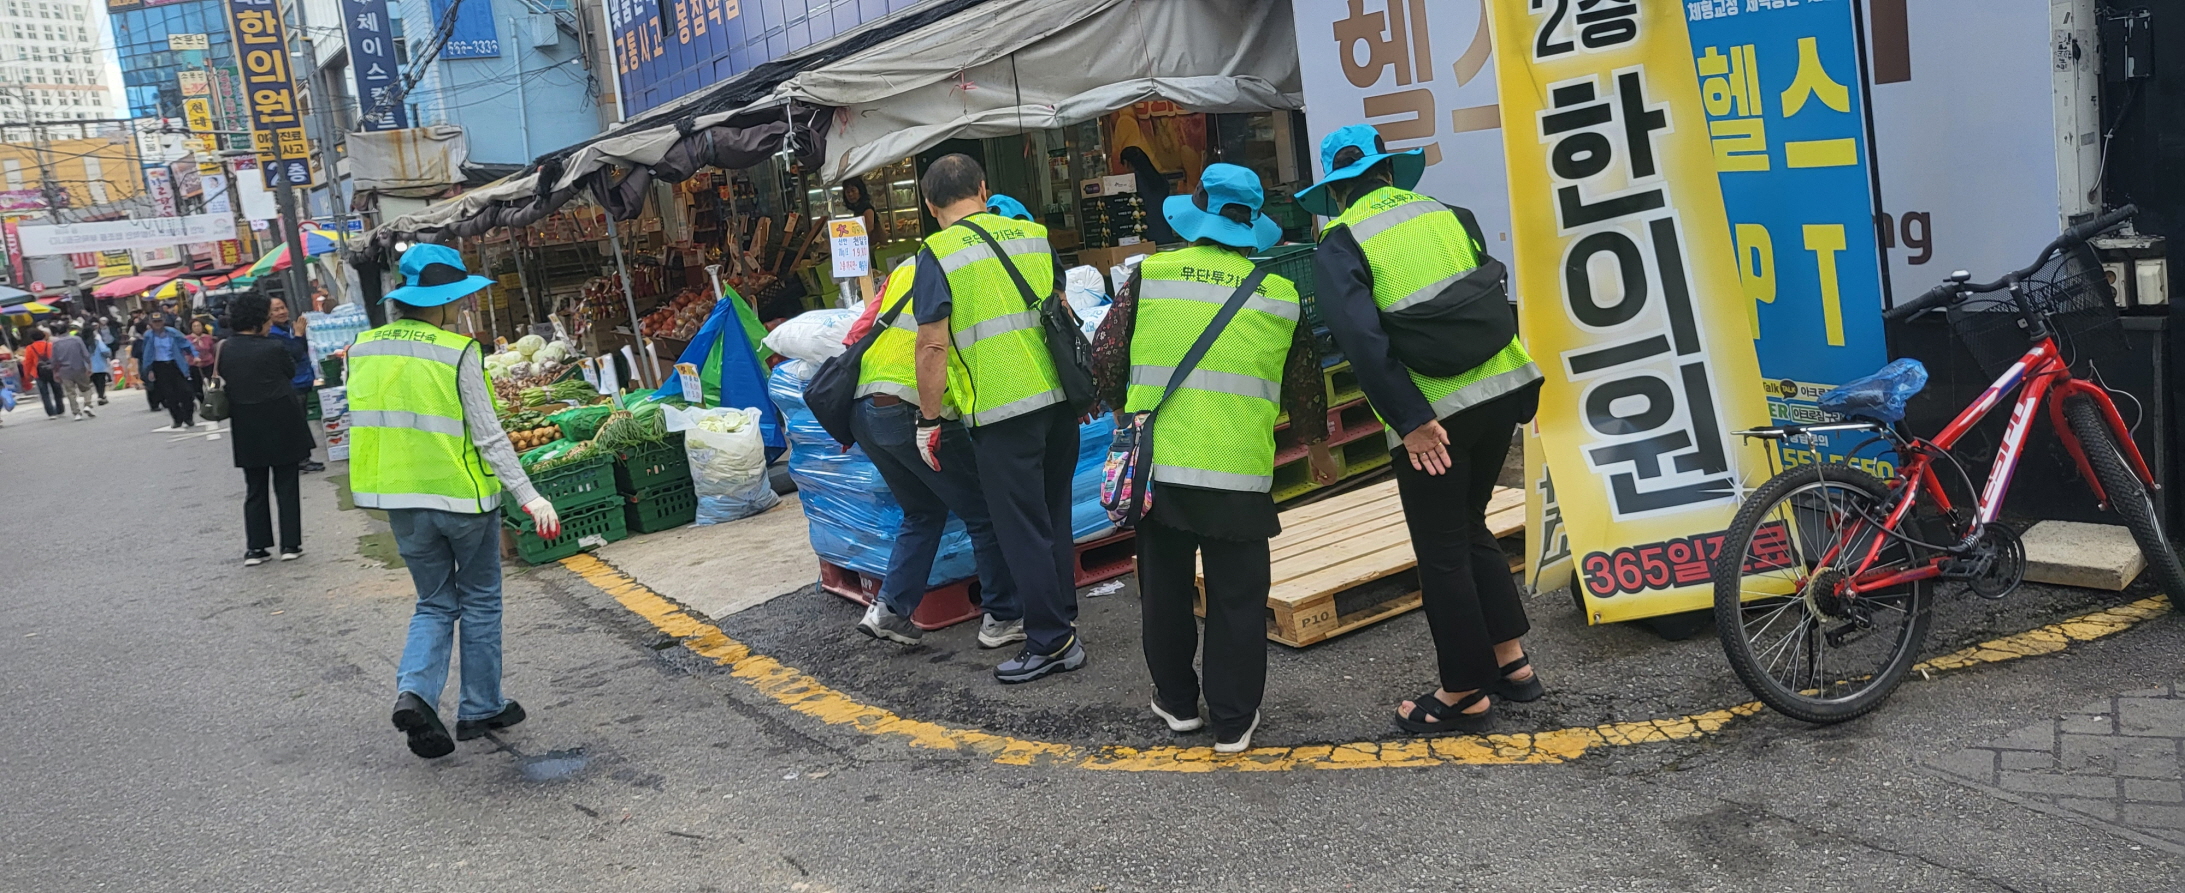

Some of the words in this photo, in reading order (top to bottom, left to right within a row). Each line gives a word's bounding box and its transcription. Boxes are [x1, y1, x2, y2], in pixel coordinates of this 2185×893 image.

[616, 15, 664, 75] 교통사고
[675, 0, 740, 46] 봉침약
[1531, 0, 1638, 59] 2층
[236, 9, 295, 124] 한의원
[1697, 36, 1858, 172] 헬스
[257, 130, 303, 144] 야진료
[259, 144, 305, 157] 교사고
[962, 228, 1026, 246] 무단기단속
[1181, 266, 1268, 297] 무단투기속
[1541, 71, 1738, 516] 한의원
[1735, 223, 1847, 347] PT
[373, 328, 438, 345] 무단투기단속
[1302, 611, 1329, 628] P10
